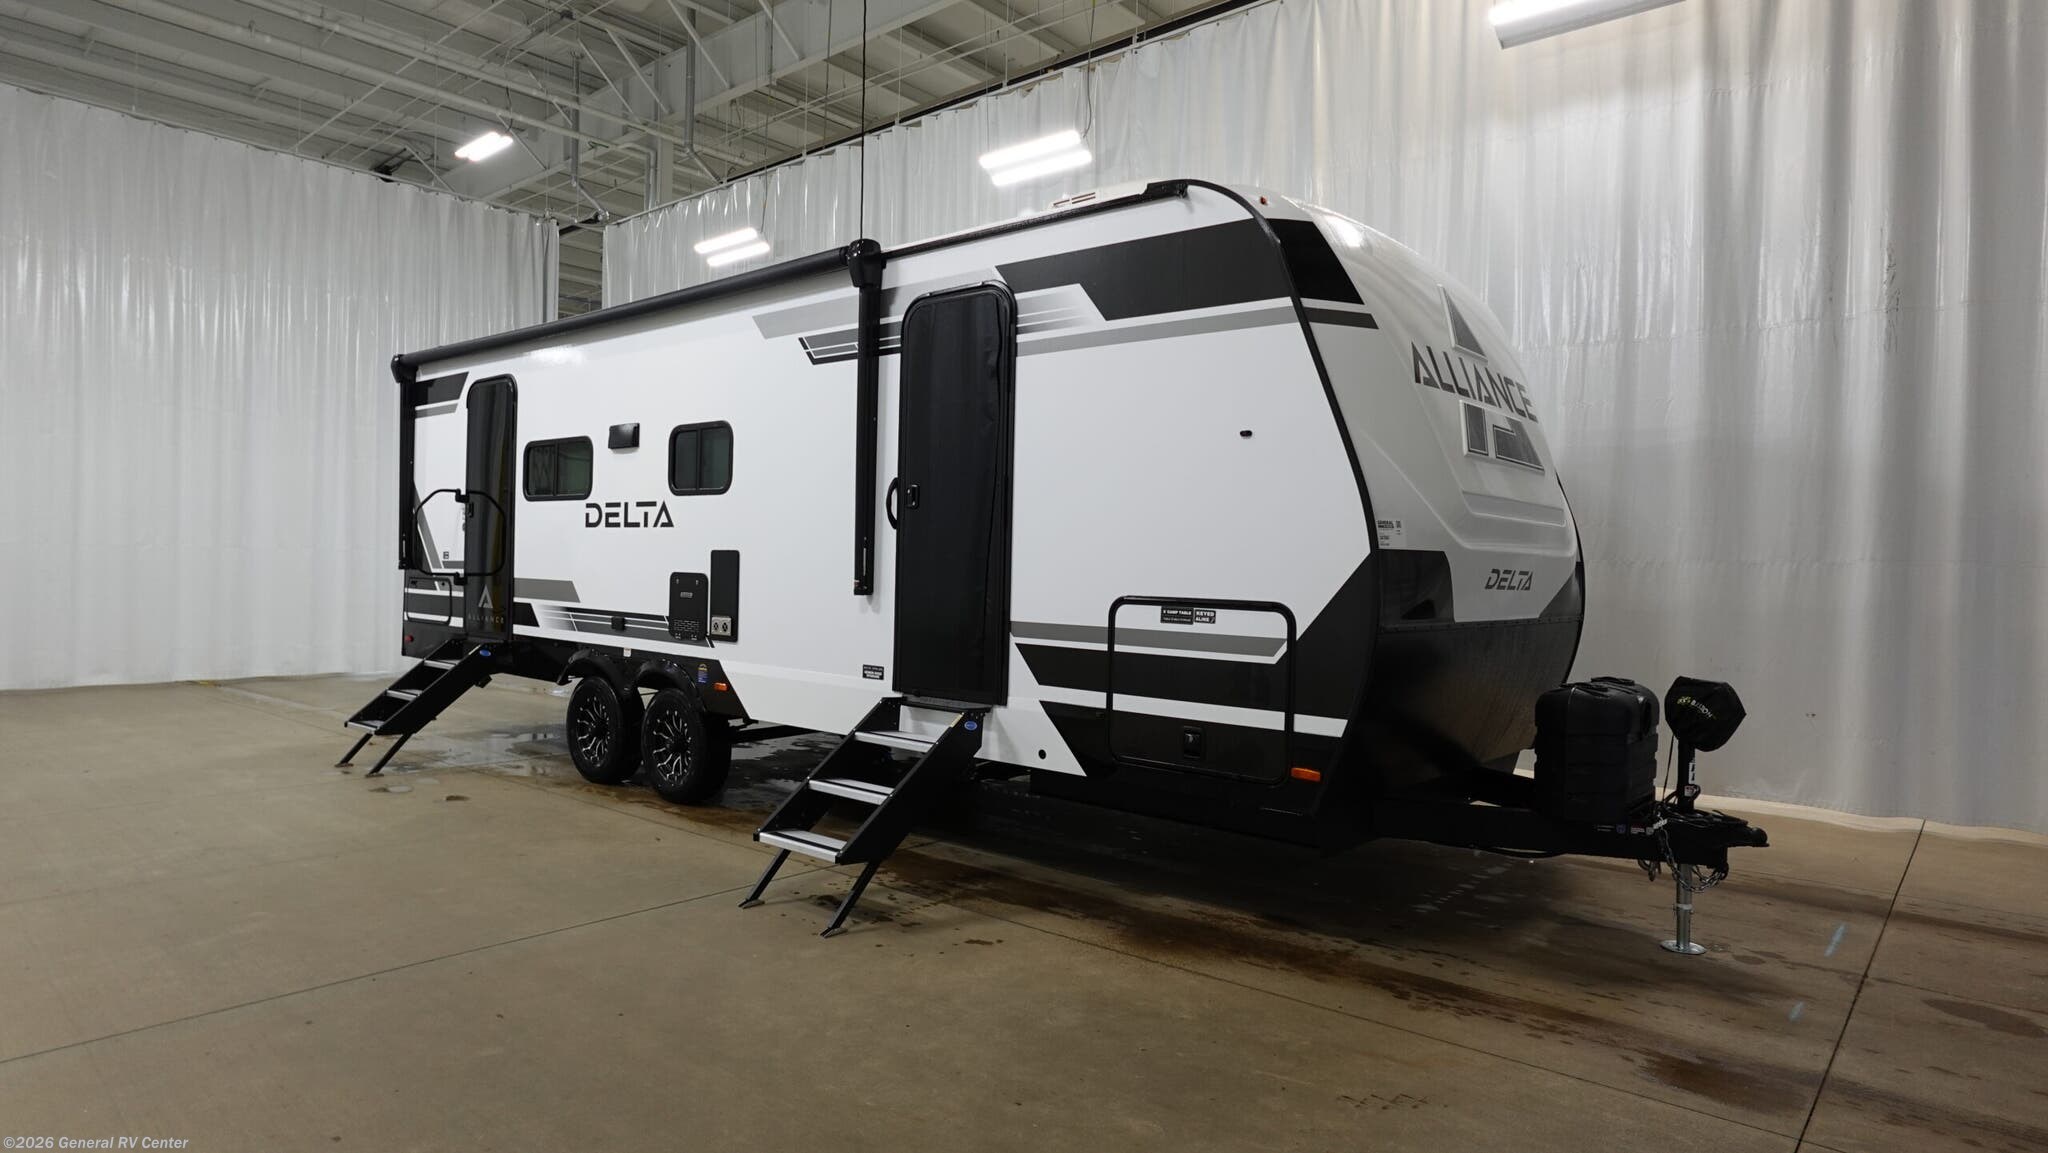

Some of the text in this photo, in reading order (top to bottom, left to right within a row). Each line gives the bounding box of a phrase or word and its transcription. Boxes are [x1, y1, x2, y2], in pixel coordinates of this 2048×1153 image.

[1411, 341, 1539, 423] ALLIANCE
[585, 500, 675, 528] DELTA
[1484, 568, 1534, 591] DELTA
